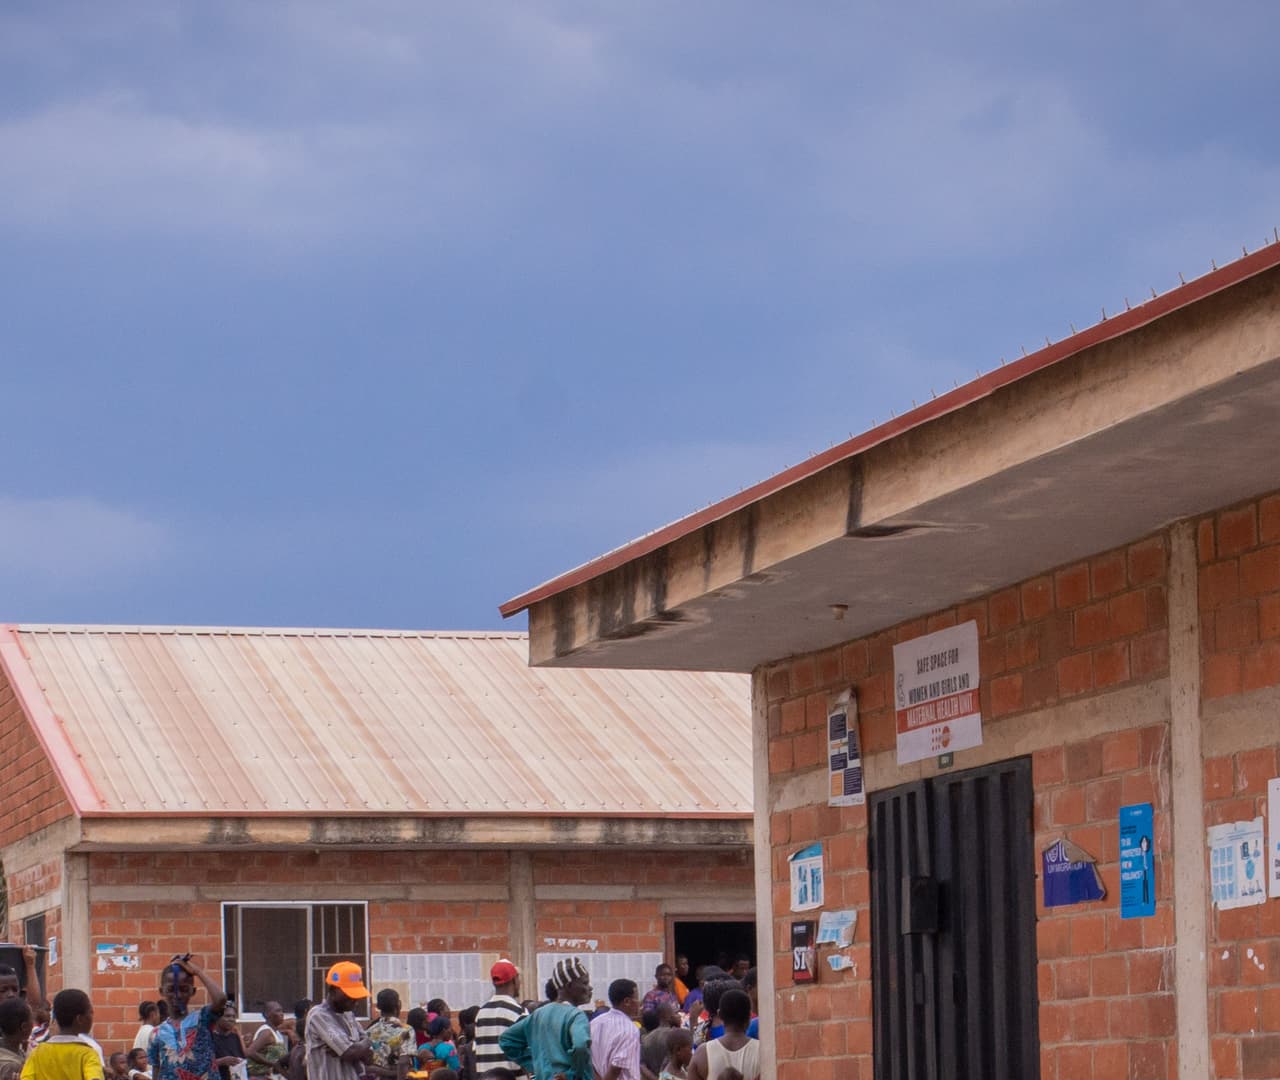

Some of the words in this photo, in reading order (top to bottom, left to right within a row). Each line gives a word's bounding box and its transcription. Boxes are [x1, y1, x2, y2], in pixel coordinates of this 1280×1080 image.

[930, 651, 947, 671] SPACE
[948, 647, 959, 665] FOR
[909, 686, 928, 704] WOMEN
[929, 681, 940, 697] AND
